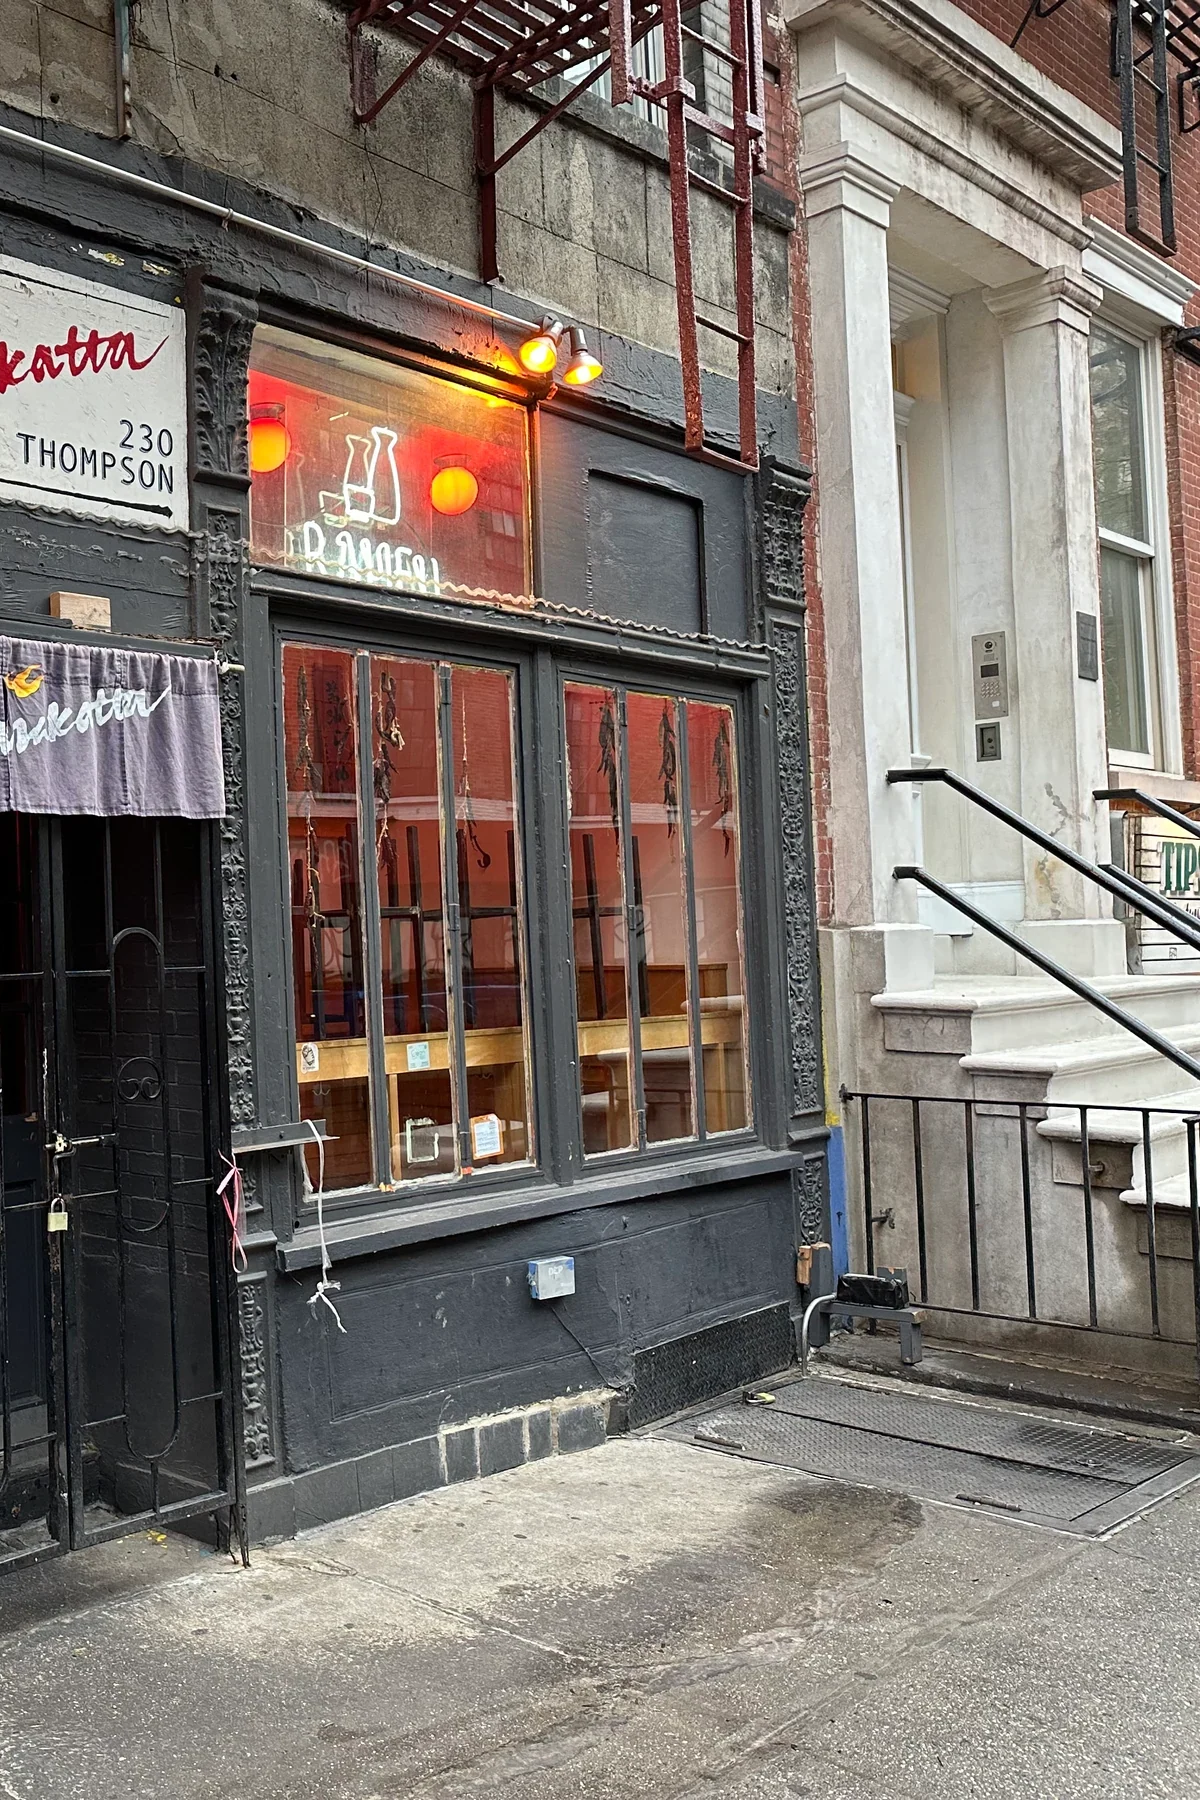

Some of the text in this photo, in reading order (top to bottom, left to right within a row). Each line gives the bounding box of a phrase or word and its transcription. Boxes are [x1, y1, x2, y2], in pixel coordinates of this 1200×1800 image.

[16, 432, 174, 494] THOMPSON
[119, 418, 174, 457] 230
[1159, 841, 1200, 892] TIP
